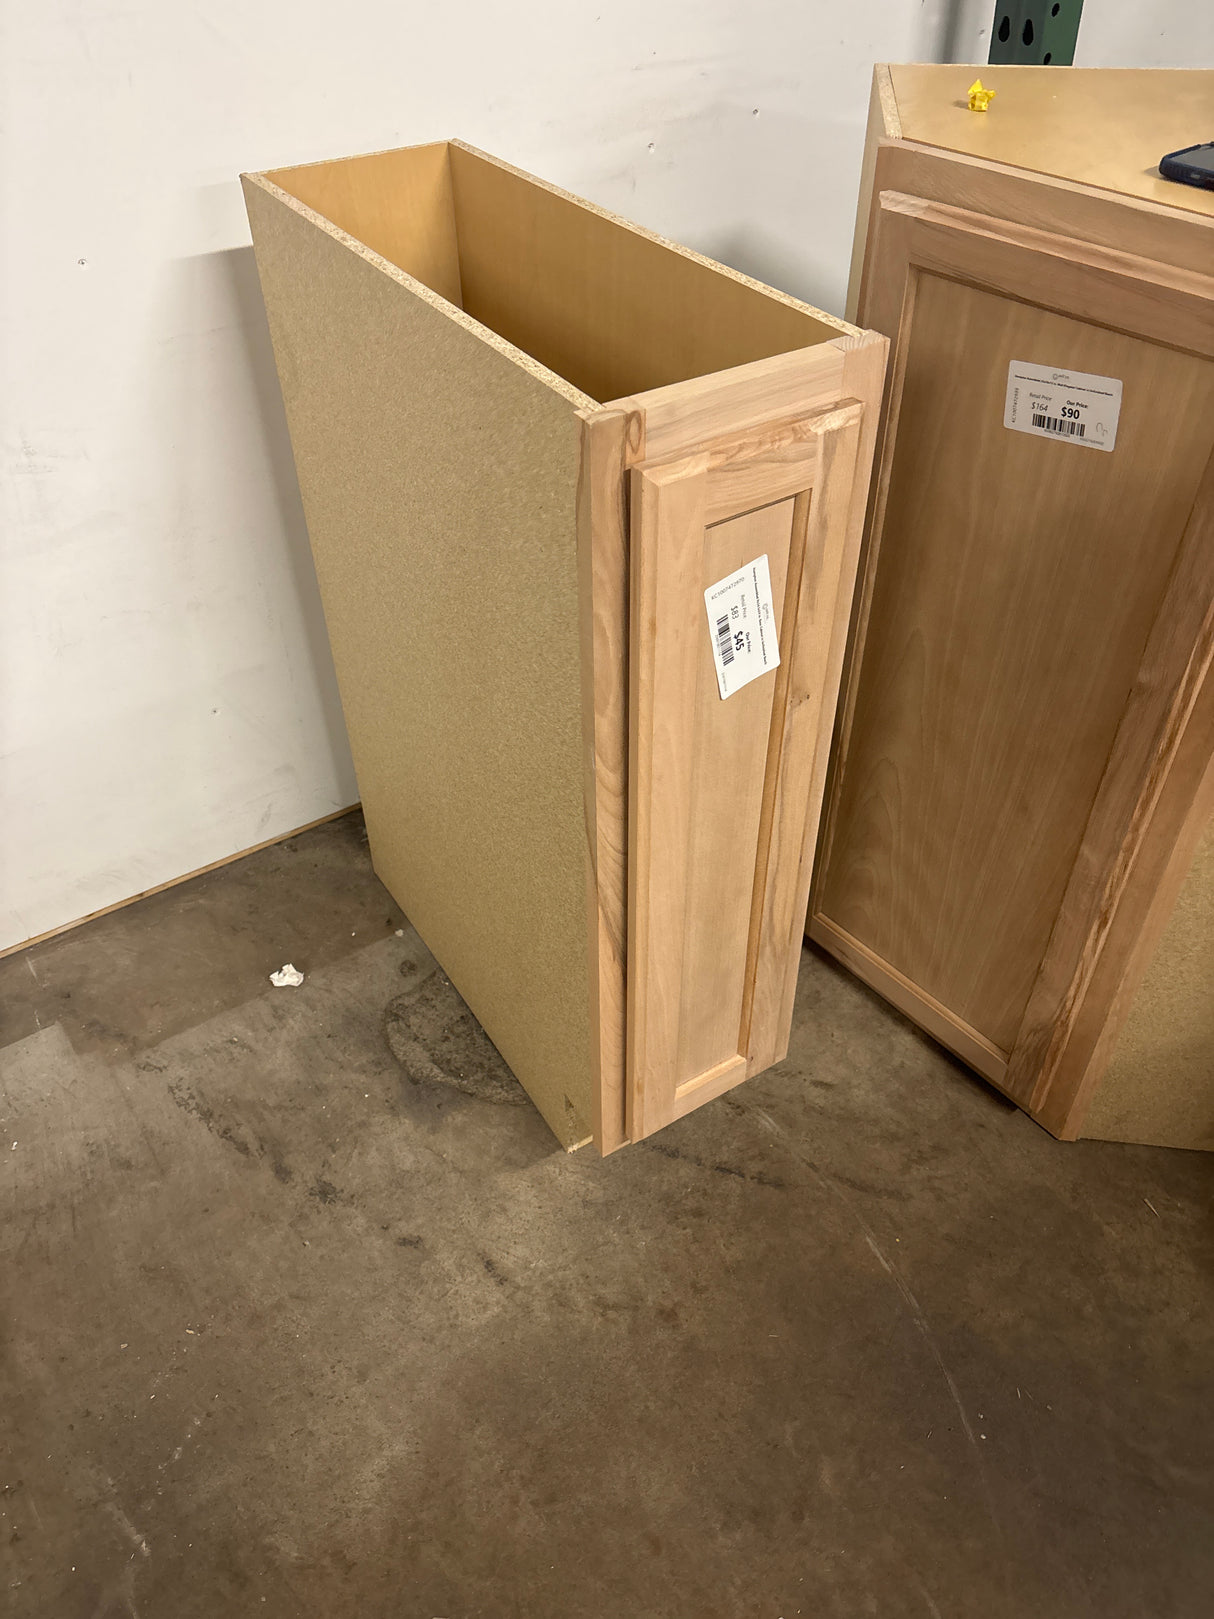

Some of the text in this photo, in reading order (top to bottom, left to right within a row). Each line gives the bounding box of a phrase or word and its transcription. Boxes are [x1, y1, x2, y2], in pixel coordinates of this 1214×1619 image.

[1032, 402, 1048, 412] $164
[1061, 407, 1080, 420] $90
[731, 605, 739, 620] $83
[734, 630, 744, 651] $45
